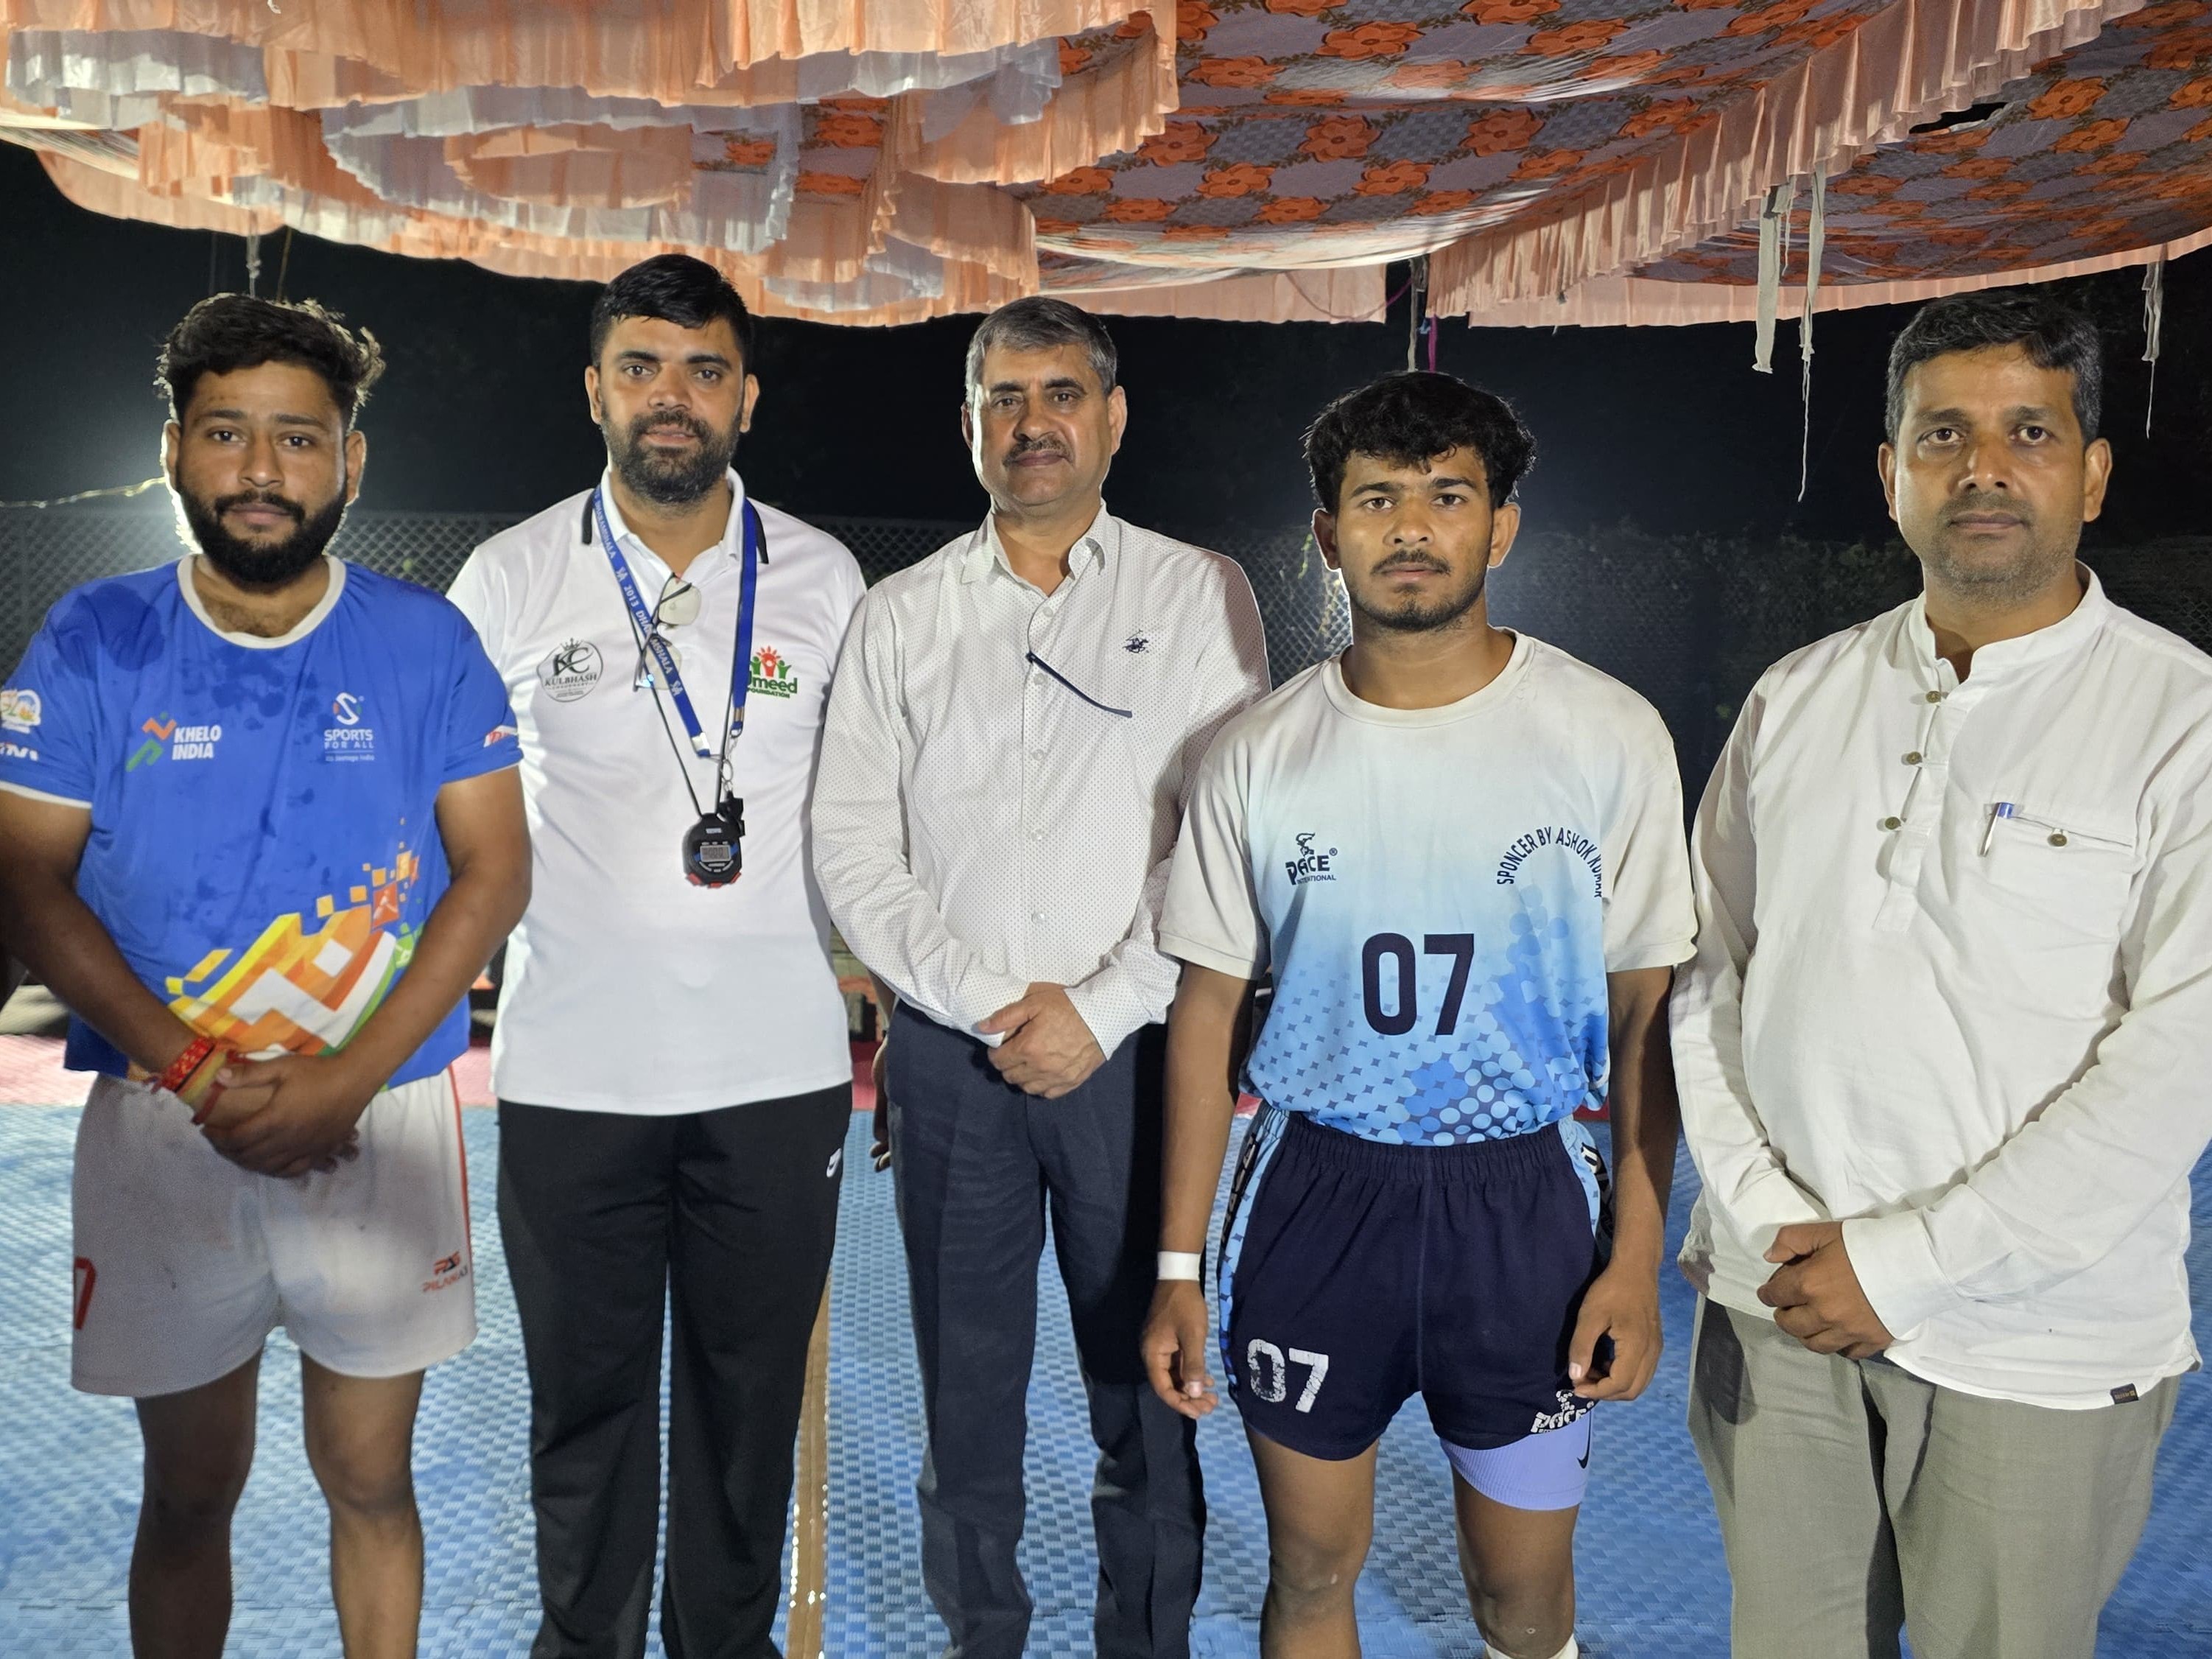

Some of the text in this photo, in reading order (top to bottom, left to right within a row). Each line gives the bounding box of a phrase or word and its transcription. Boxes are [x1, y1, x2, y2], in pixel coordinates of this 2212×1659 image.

[623, 585, 639, 608] 2013
[544, 673, 597, 687] KULBHASH
[174, 725, 222, 743] KHELO
[324, 729, 373, 741] SPORTS
[172, 742, 214, 760] INDIA
[324, 741, 374, 749] FOR ALL
[1497, 833, 1539, 885] SPONCER
[1535, 826, 1552, 846] BY
[1555, 827, 1598, 861] ASHOK
[1362, 933, 1474, 1036] 07
[1247, 1339, 1329, 1413] 07
